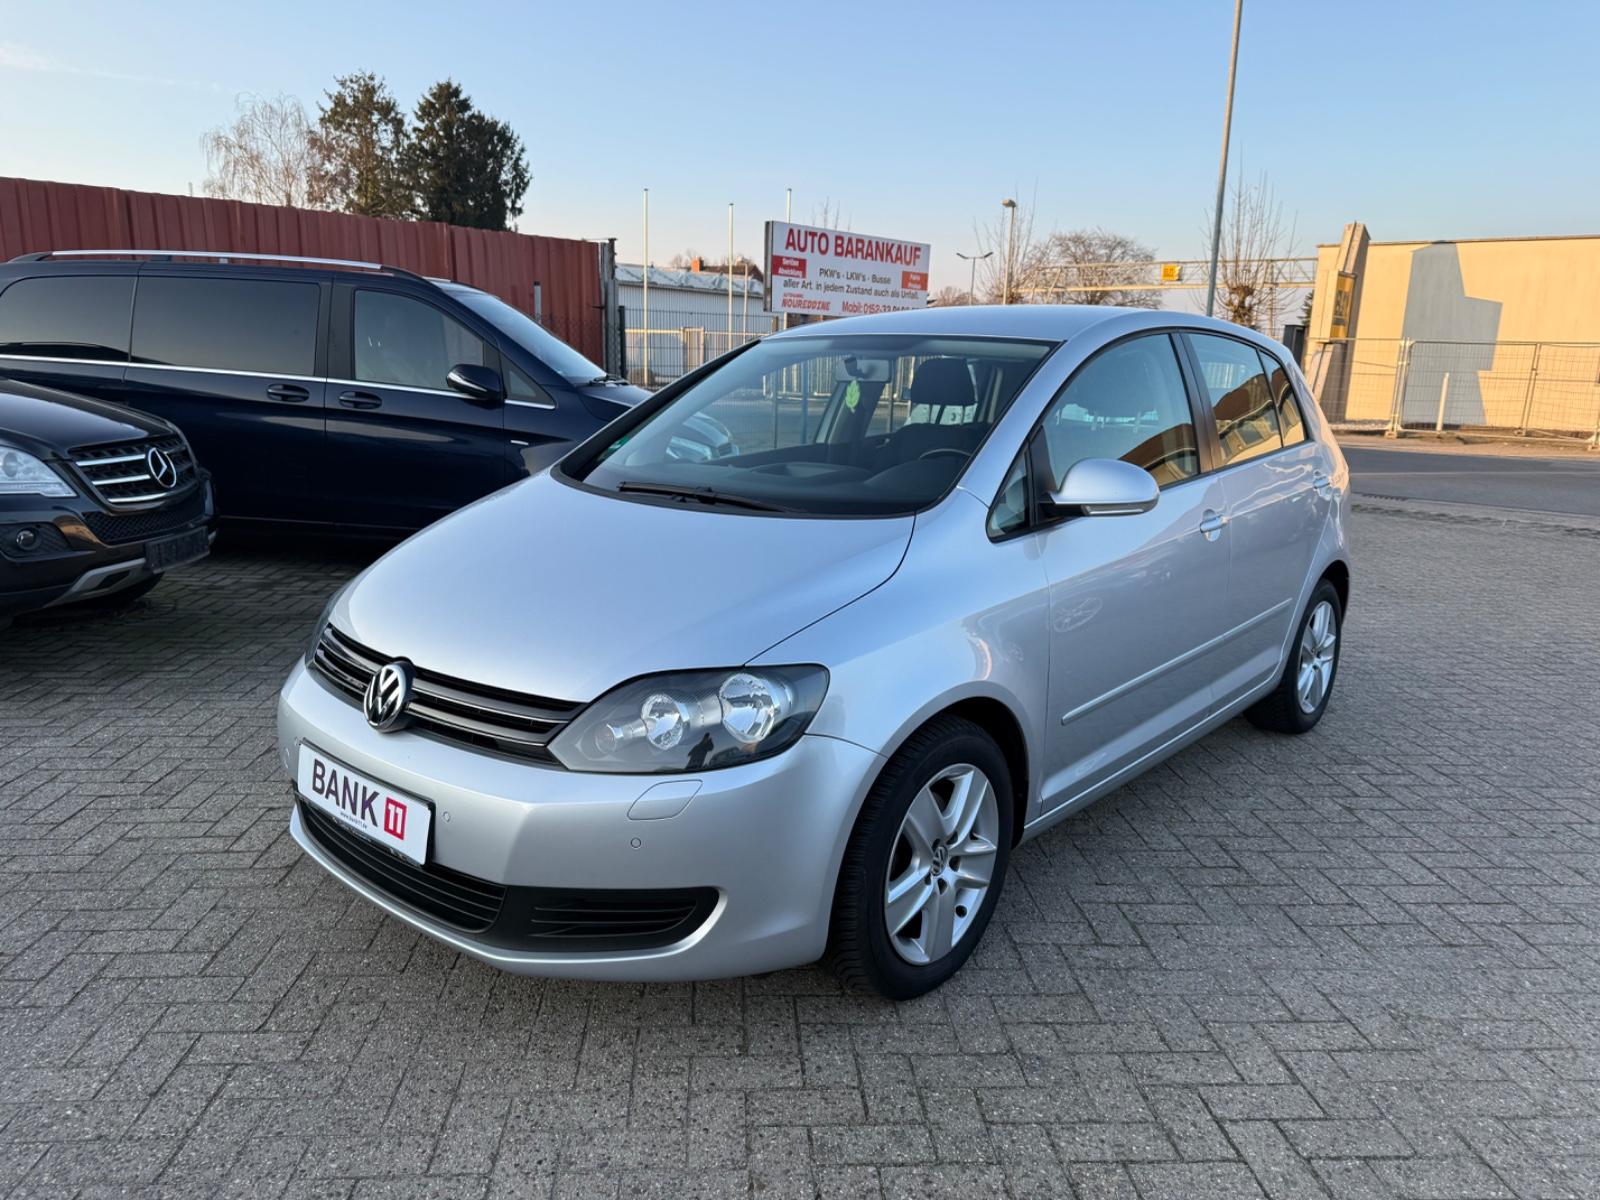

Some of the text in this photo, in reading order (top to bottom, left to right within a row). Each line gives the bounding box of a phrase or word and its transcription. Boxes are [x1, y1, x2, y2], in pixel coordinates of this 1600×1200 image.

[785, 228, 921, 266] AUTO BARANKAUF
[783, 279, 800, 289] aller
[815, 281, 822, 290] in
[823, 282, 844, 293] jedem
[845, 284, 873, 296] Zustand
[873, 288, 890, 298] auch
[890, 289, 900, 298] als
[819, 267, 892, 285] PKW's LKW's Busse
[312, 758, 380, 828] BANK
